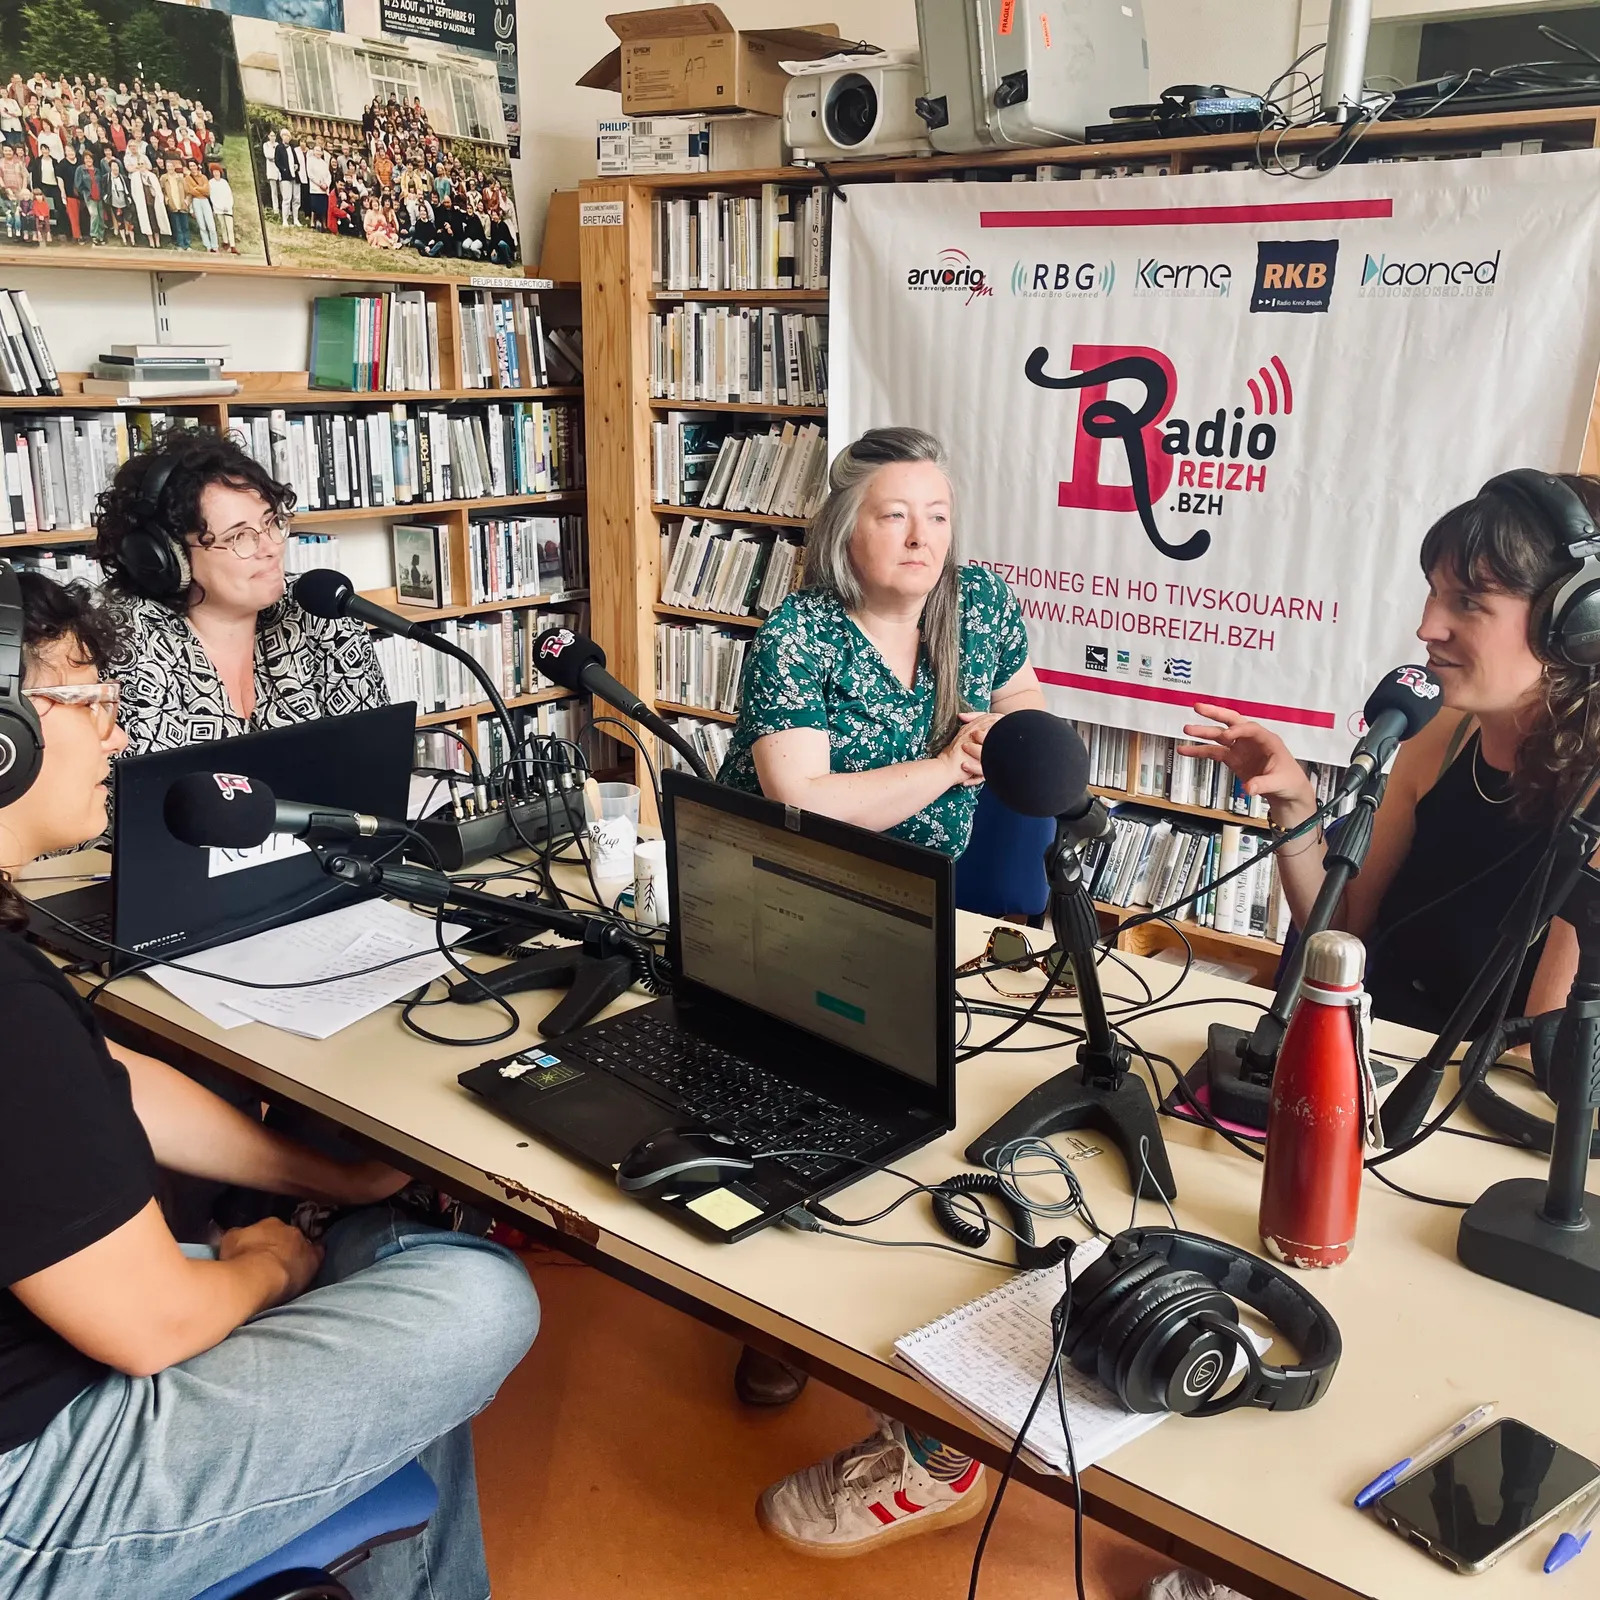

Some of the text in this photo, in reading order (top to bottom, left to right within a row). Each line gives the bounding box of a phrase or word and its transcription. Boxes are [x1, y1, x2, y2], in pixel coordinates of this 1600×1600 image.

[385, 10, 407, 22] PEUPLES
[408, 14, 443, 29] ABORIGENES
[443, 21, 476, 36] D'AUSTRALIE
[435, 6, 467, 22] SEPTEMBRE
[467, 13, 476, 24] 91
[1002, 1, 1011, 33] FRAGILE
[633, 46, 651, 55] EPSON
[582, 214, 621, 225] BRETAGNE
[1032, 263, 1096, 290] RBG
[1135, 258, 1232, 290] Kerne
[1263, 263, 1328, 289] RKB
[1360, 249, 1501, 287] Naoned
[472, 277, 552, 290] PEUPLES DE L'ARCTIQUE
[1022, 290, 1099, 299] Radio Bro Gwened
[1357, 285, 1496, 299] RADIONAONED.BZH
[1276, 299, 1291, 307] Radio
[1305, 299, 1323, 307] Breizh
[420, 433, 430, 463] FORT
[1169, 492, 1224, 516] .BZH
[1092, 575, 1122, 598] EN
[1127, 580, 1158, 602] HO
[1165, 584, 1323, 621] TIVSKOUARN
[1332, 602, 1339, 623] !
[1163, 677, 1191, 685] MORBIHAN
